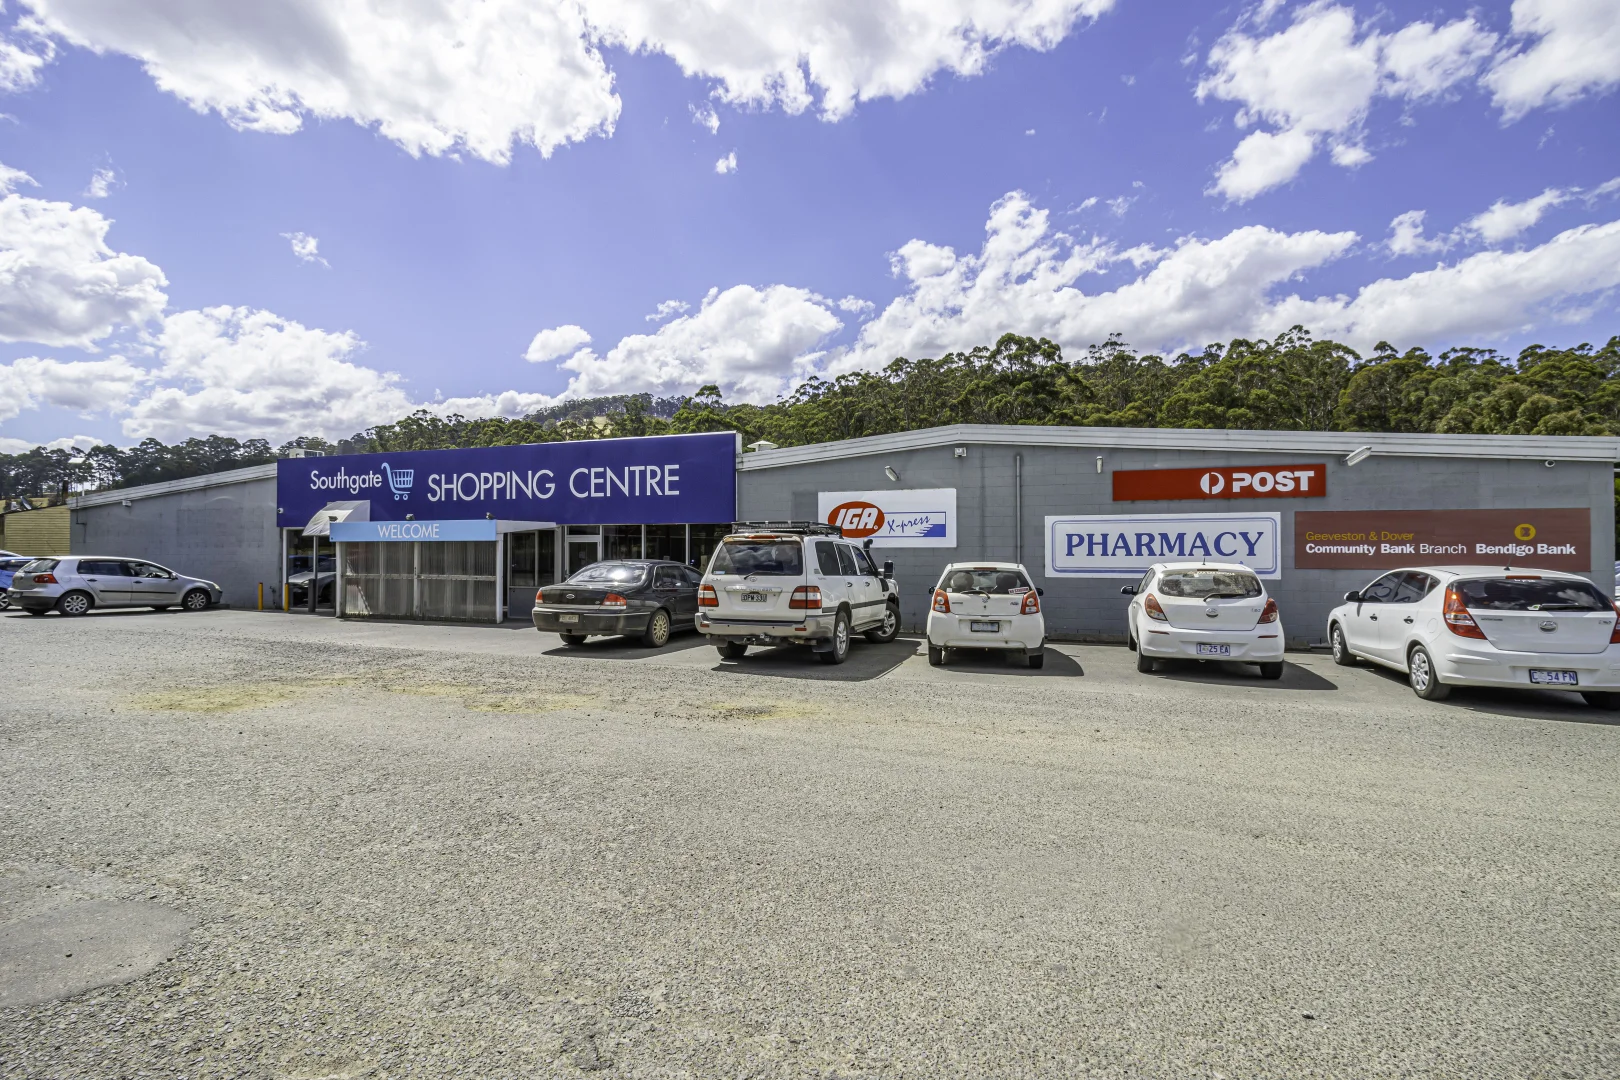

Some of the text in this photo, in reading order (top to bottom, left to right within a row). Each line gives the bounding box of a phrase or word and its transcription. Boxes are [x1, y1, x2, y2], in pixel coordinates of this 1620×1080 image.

[310, 467, 383, 494] Southgate
[427, 464, 680, 502] SHOPPING CENTRE
[1232, 471, 1314, 492] POST
[835, 508, 878, 529] IGA
[887, 515, 931, 534] X-press
[377, 523, 440, 539] WELCOME
[1305, 531, 1414, 541] Geeveston & Dover
[1065, 531, 1264, 557] PHARMACY
[1305, 543, 1467, 556] Community Bank Branch
[1475, 543, 1576, 557] Bendigo Bank
[1546, 671, 1560, 681] 54
[1562, 672, 1576, 682] FN
